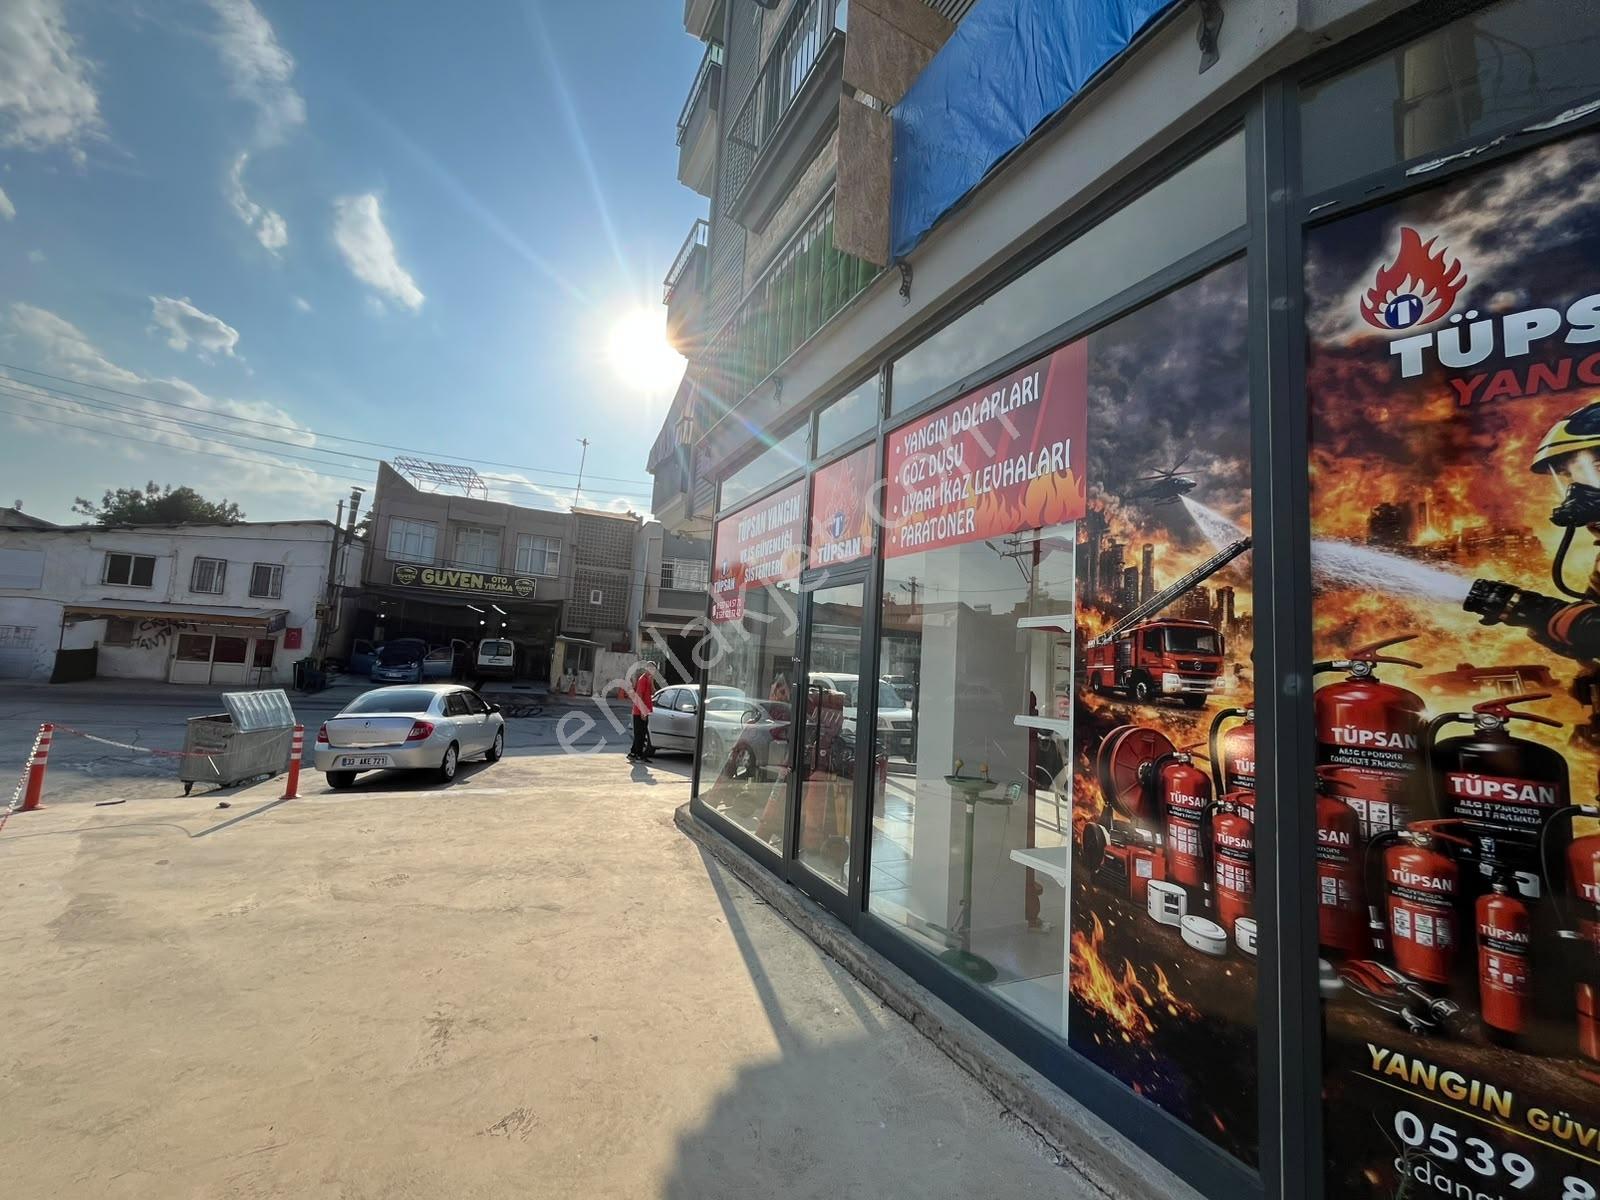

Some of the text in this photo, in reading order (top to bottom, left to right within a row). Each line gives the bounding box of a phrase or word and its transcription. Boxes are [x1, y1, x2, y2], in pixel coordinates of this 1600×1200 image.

[904, 372, 1040, 456] YANGIN DOLAPLARI
[903, 456, 926, 486] GÖZ
[902, 487, 935, 517] UYARI
[940, 473, 970, 505] İKAZ
[738, 495, 801, 543] TÜPSAN YANGIN
[901, 508, 975, 547] PARATONER
[484, 582, 513, 593] YIKAMA
[491, 576, 508, 585] OTO
[1367, 1042, 1514, 1119] YANGIN
[1394, 1110, 1536, 1190] 0539
